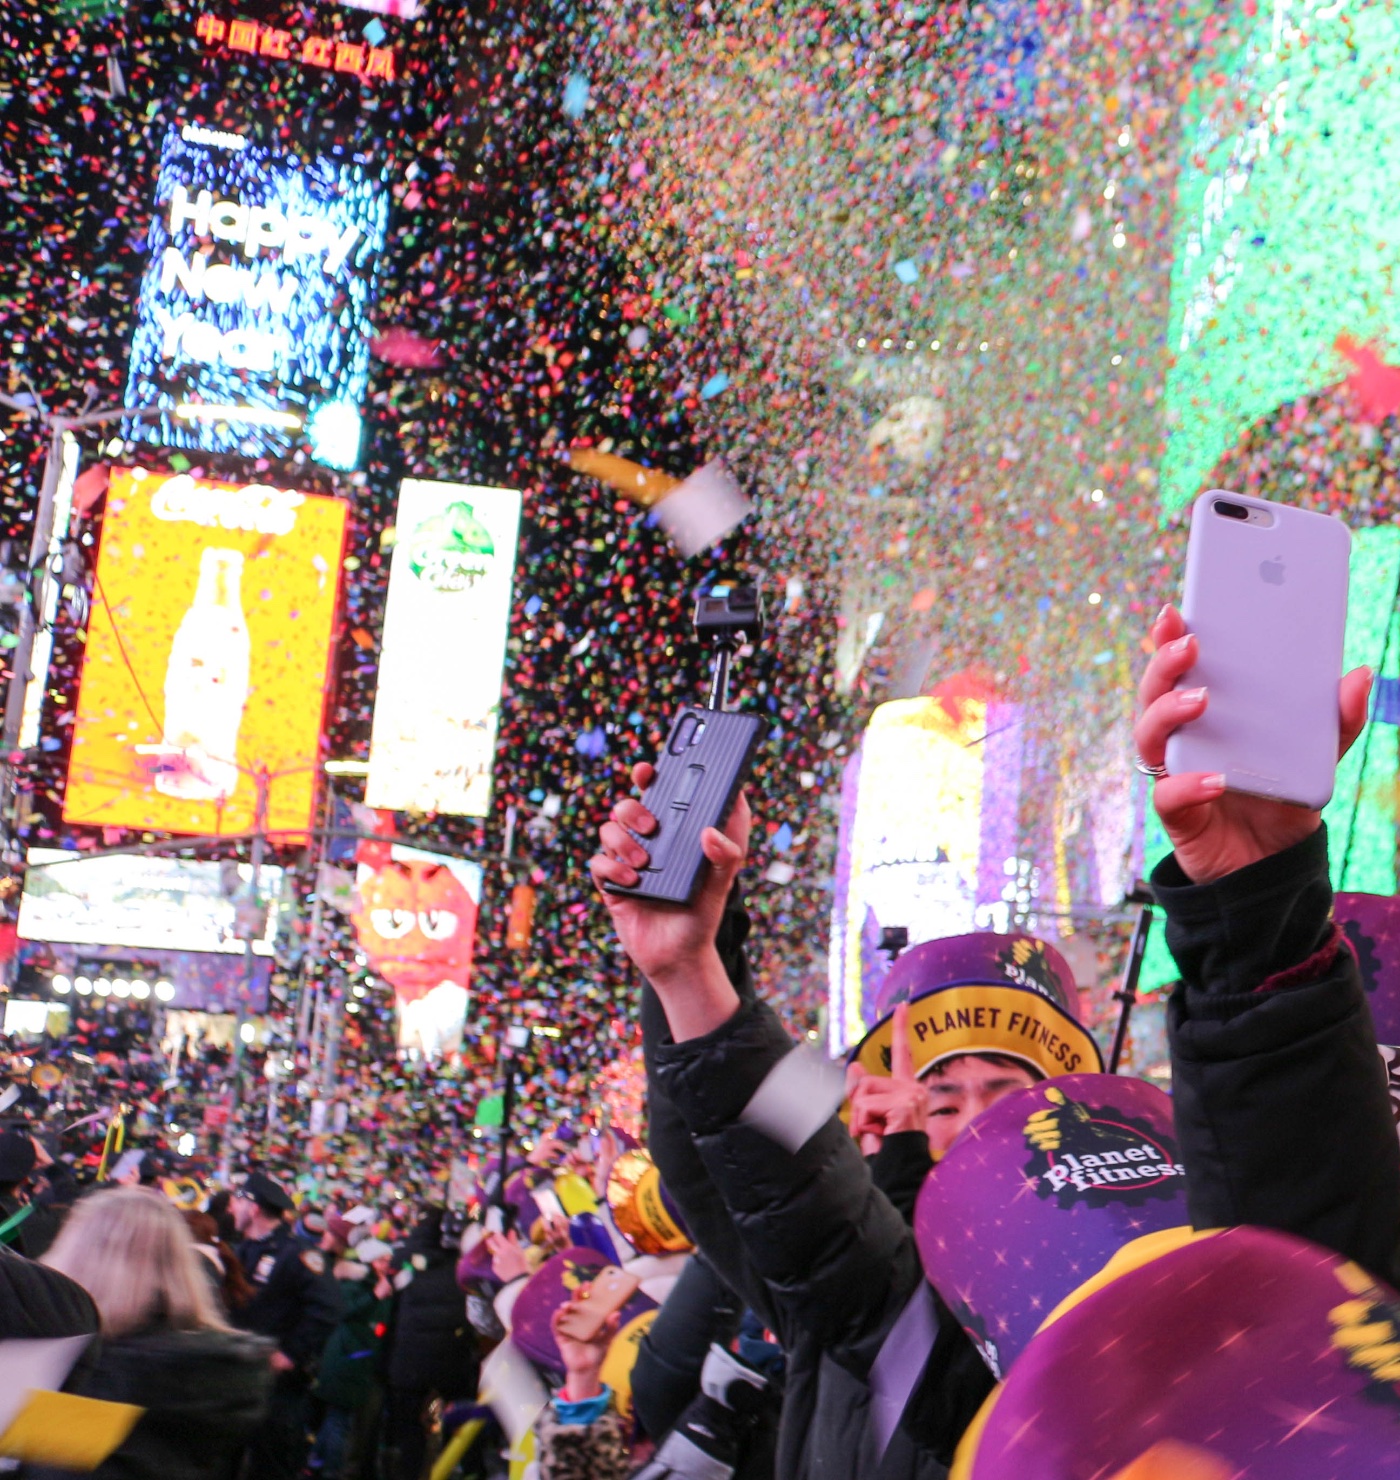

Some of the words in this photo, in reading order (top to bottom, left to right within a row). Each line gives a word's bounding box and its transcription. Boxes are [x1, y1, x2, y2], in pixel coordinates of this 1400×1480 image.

[170, 185, 360, 273] Happy
[160, 246, 299, 313] New
[156, 306, 288, 371] Year
[913, 1007, 1002, 1043] PLANET
[1007, 1012, 1082, 1073] FITNESS
[1043, 1144, 1161, 1192] planet
